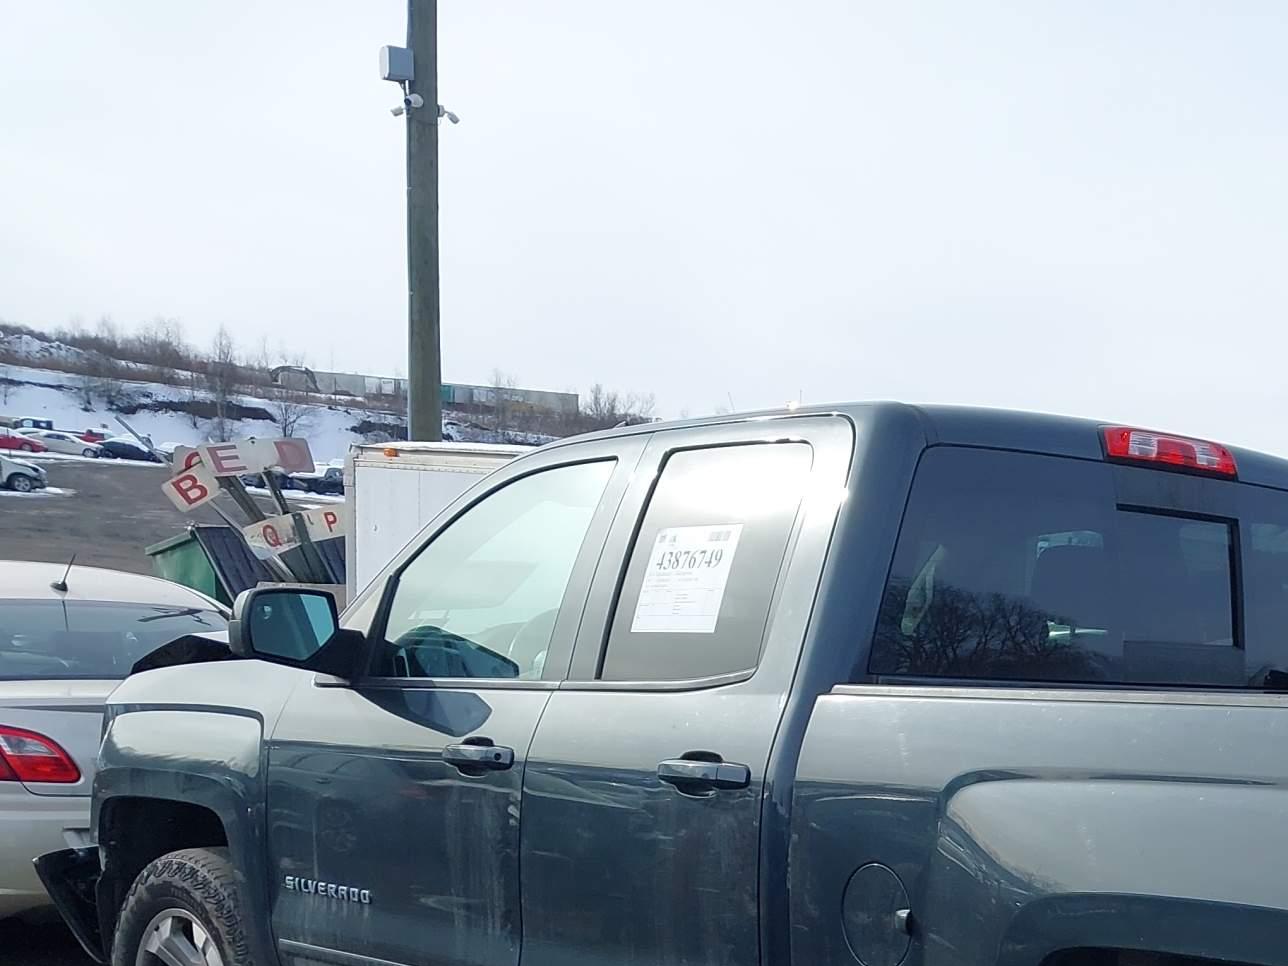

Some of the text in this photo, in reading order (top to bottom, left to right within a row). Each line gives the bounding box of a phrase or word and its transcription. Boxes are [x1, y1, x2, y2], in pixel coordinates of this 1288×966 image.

[206, 444, 248, 473] E
[171, 474, 209, 506] B
[323, 511, 338, 533] P
[262, 524, 283, 548] Q
[656, 548, 724, 570] 43876749
[285, 875, 371, 904] SILVERADO
